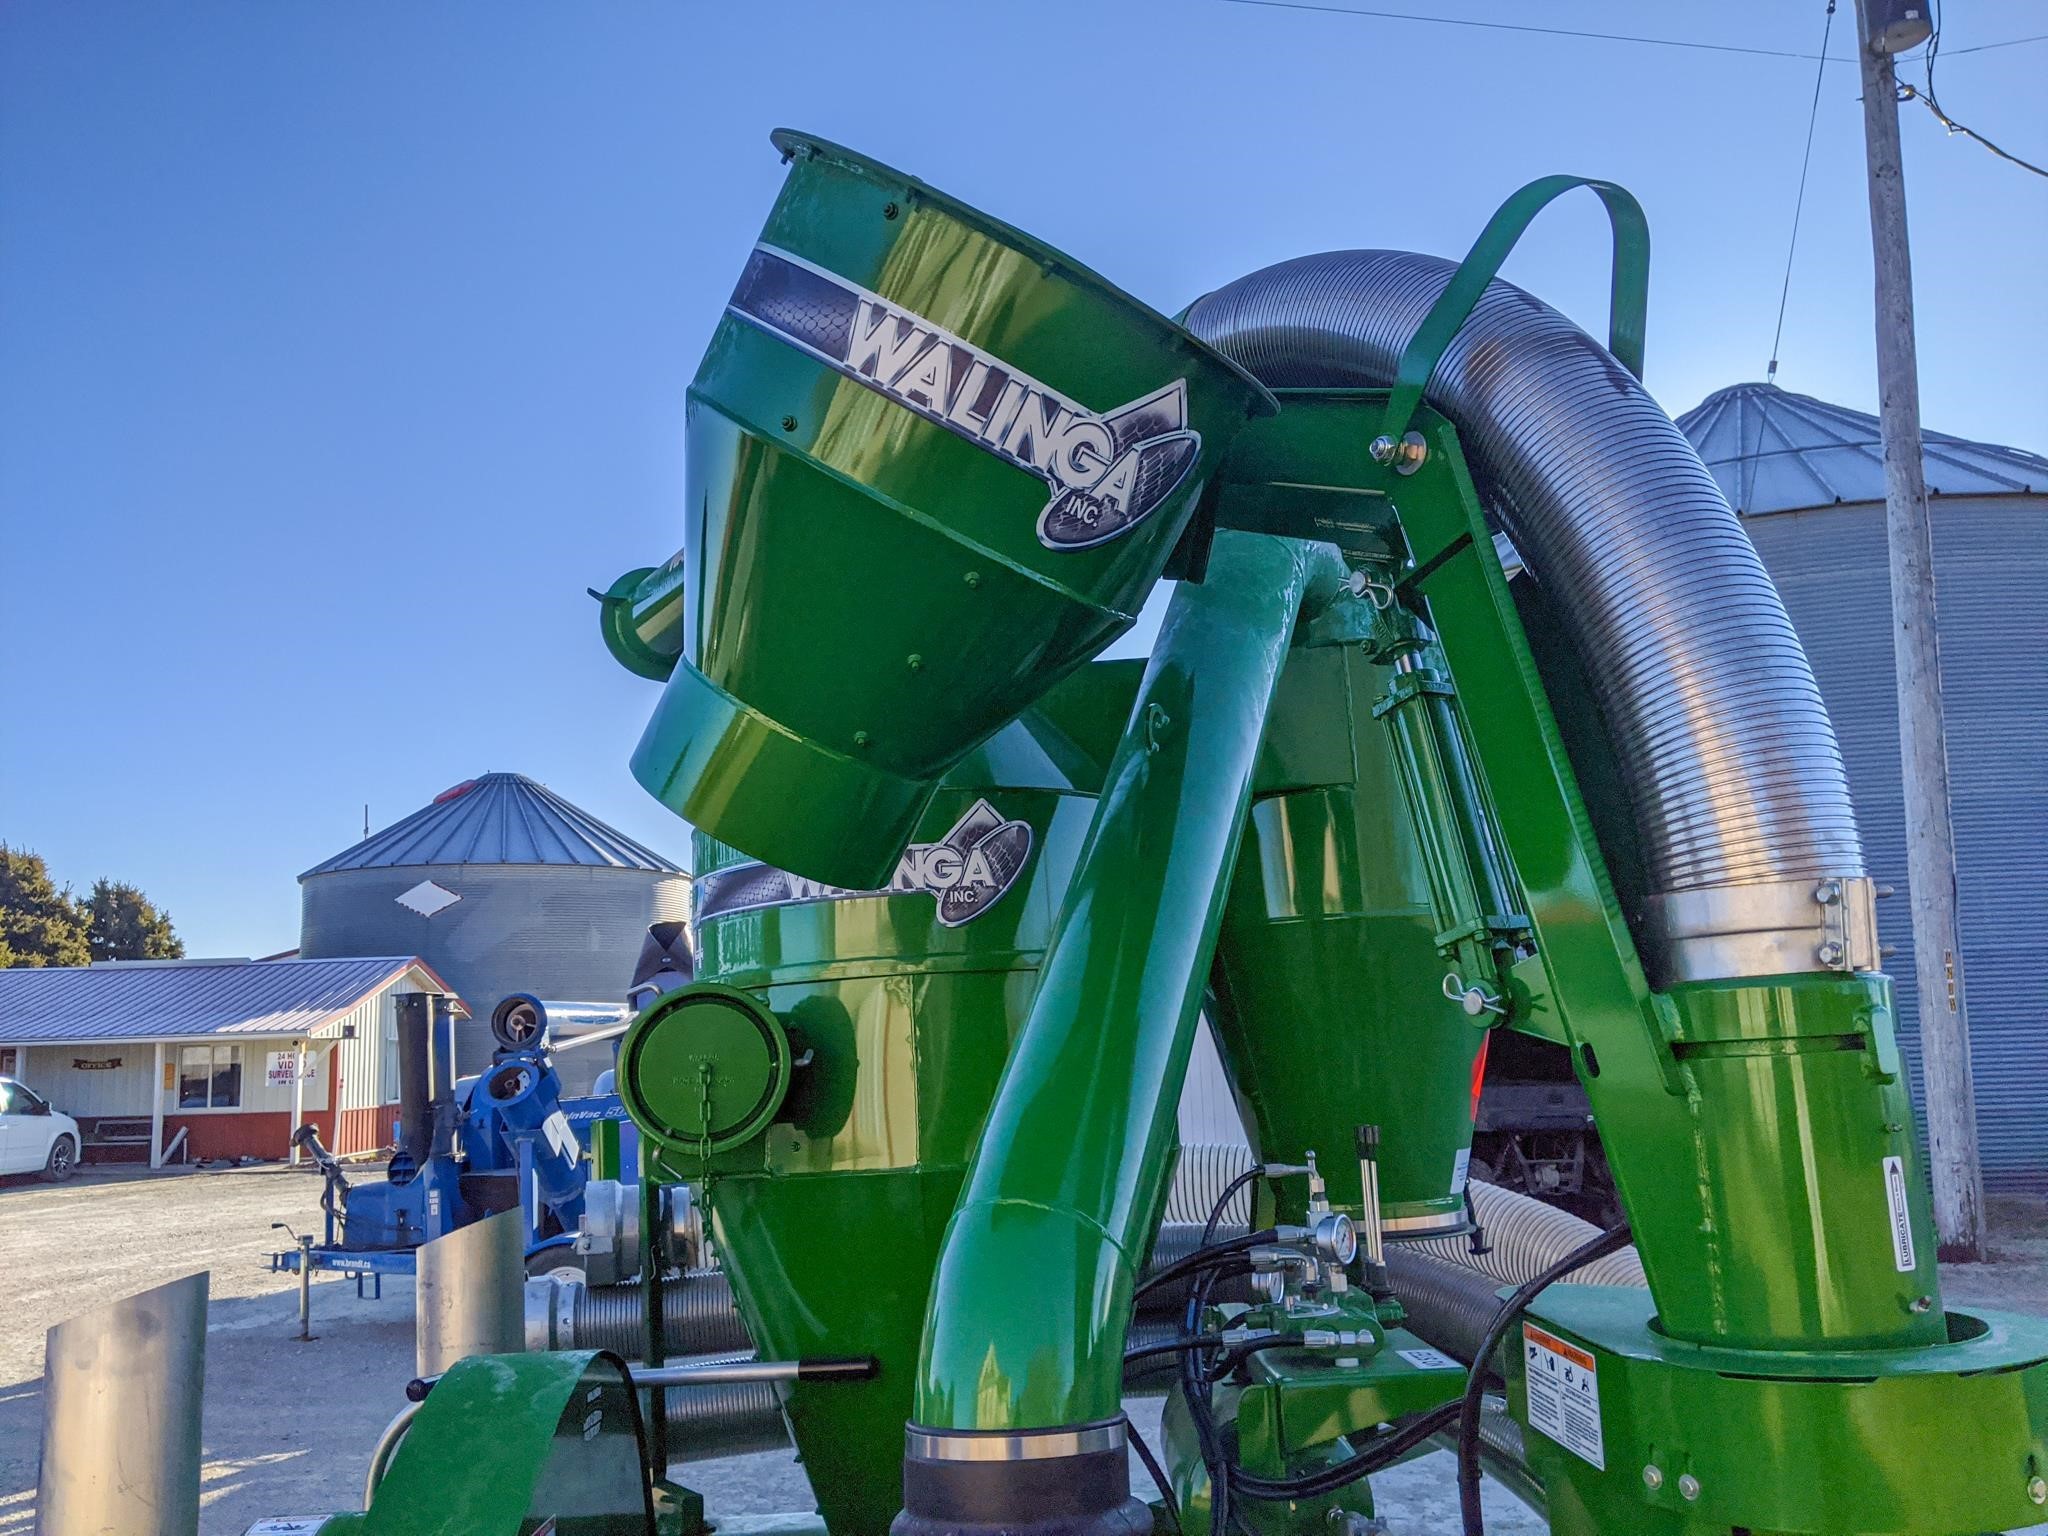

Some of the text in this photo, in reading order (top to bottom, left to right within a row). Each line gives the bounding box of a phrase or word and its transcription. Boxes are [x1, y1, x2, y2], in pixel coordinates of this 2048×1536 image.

[846, 299, 1141, 516] WALINGA
[1066, 497, 1099, 528] INC.
[949, 890, 978, 903] INC.
[1898, 1212, 1910, 1263] LUBRICATE
